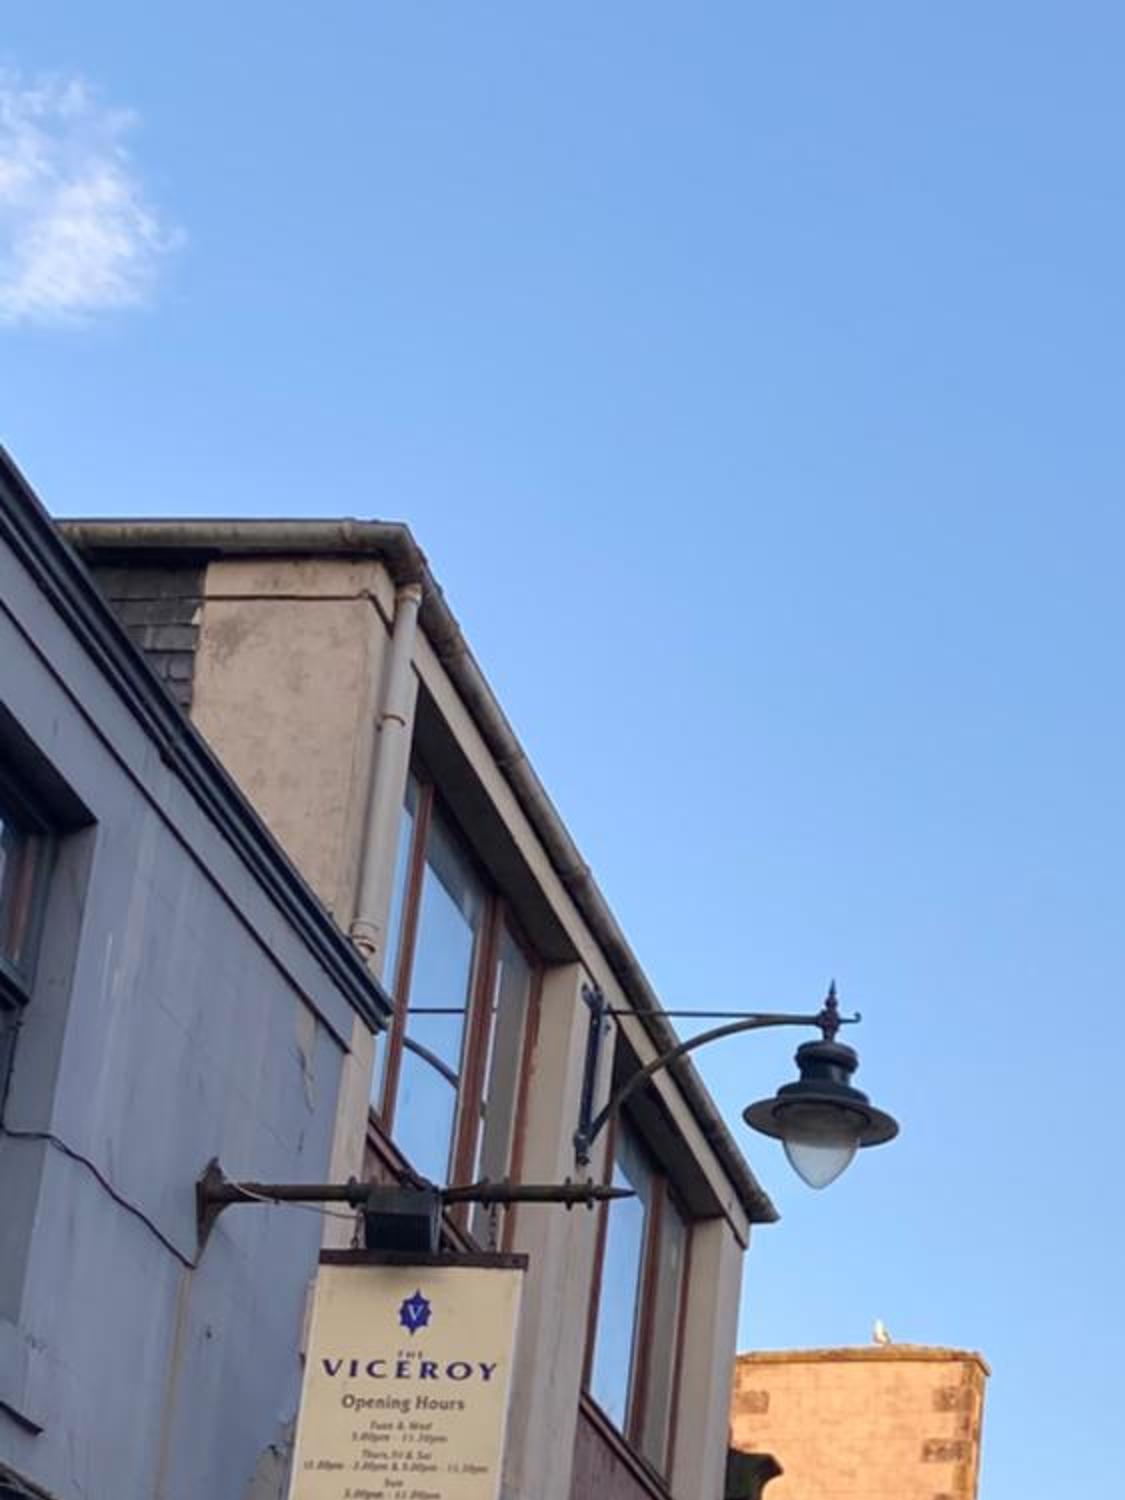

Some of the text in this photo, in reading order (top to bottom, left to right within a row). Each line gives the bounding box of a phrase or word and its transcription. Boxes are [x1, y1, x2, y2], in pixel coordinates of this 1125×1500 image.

[321, 1358, 498, 1382] VICEROY
[341, 1393, 466, 1414] Opening Hours
